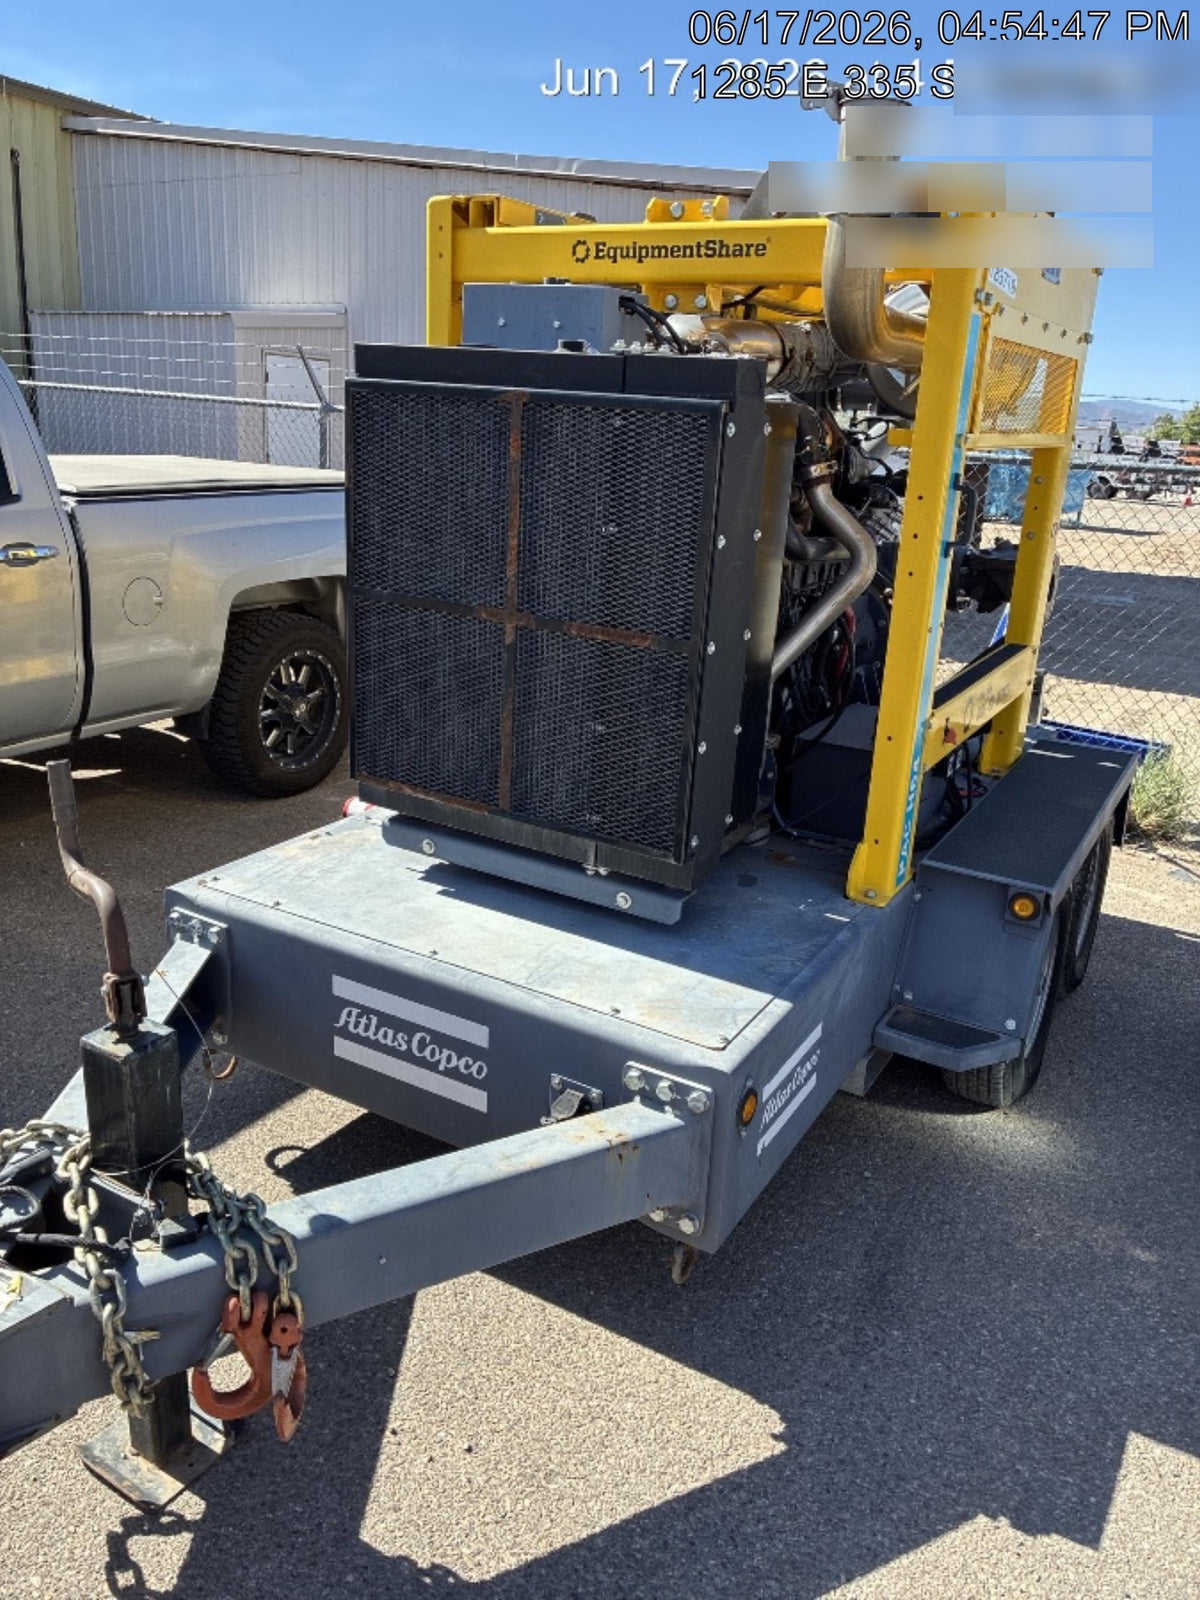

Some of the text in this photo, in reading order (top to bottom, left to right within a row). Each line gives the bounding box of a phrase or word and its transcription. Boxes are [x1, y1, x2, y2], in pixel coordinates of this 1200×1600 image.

[593, 239, 767, 264] EquipmentShare
[333, 1006, 488, 1080] Atlas Copco
